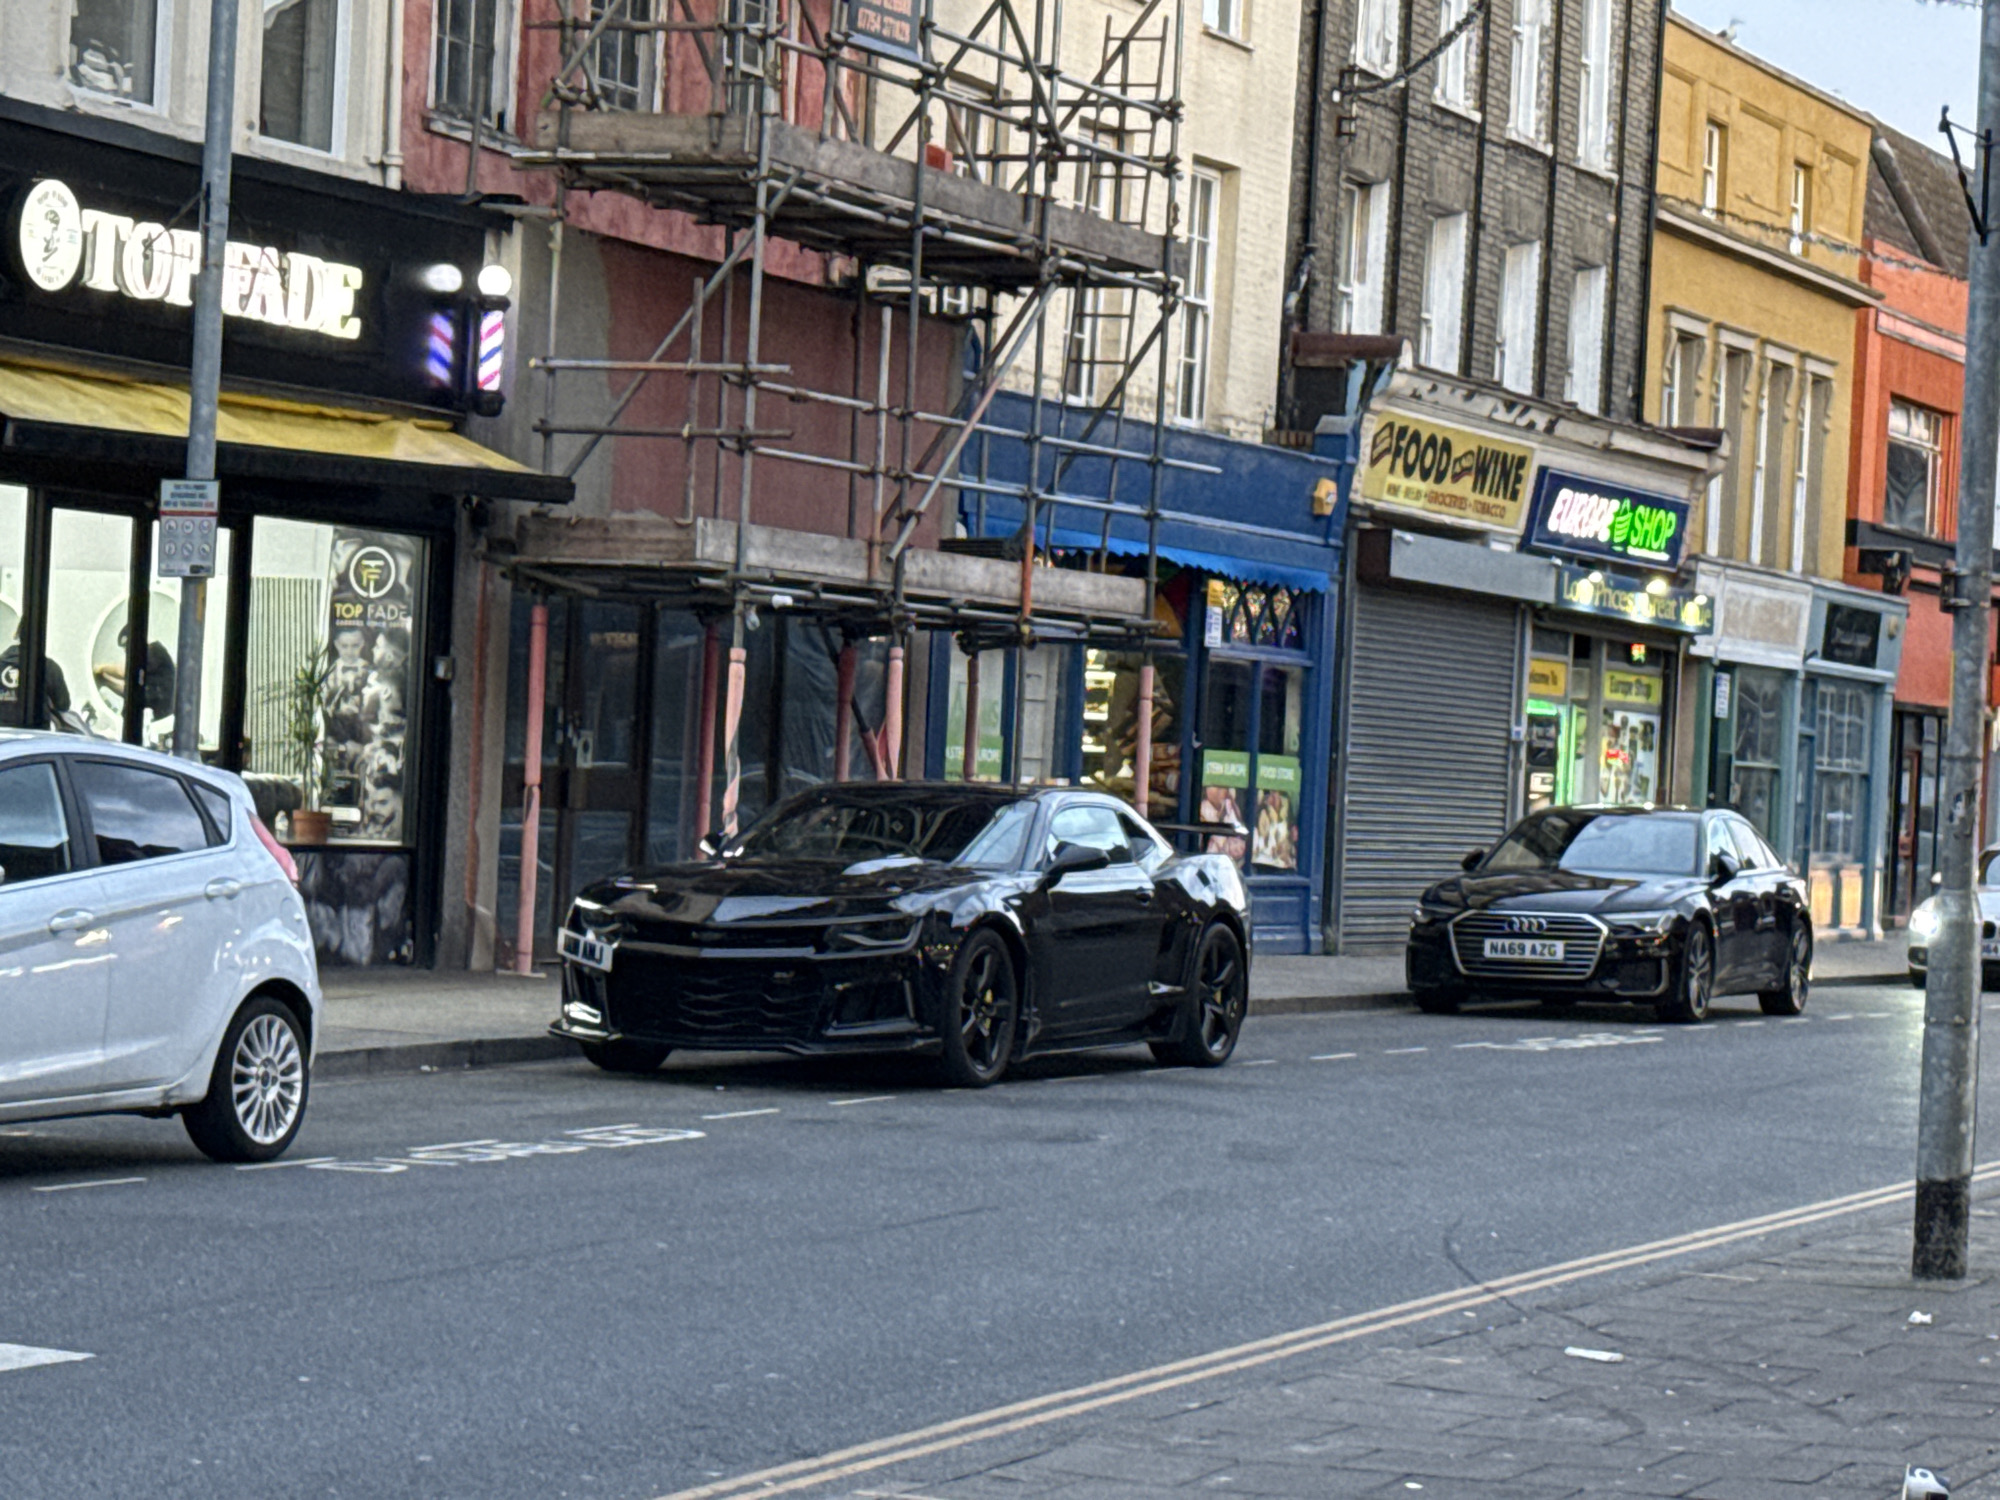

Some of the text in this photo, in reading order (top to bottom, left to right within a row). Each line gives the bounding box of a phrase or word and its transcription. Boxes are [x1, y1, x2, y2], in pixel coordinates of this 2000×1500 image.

[81, 208, 363, 340] TOP FADE
[1389, 425, 1528, 502] FOOD WINE
[1548, 488, 1678, 550] EUROPE SHOP
[335, 603, 407, 621] TOP FADE
[1562, 571, 1594, 605] Lo
[1489, 941, 1557, 957] NA69 AZG
